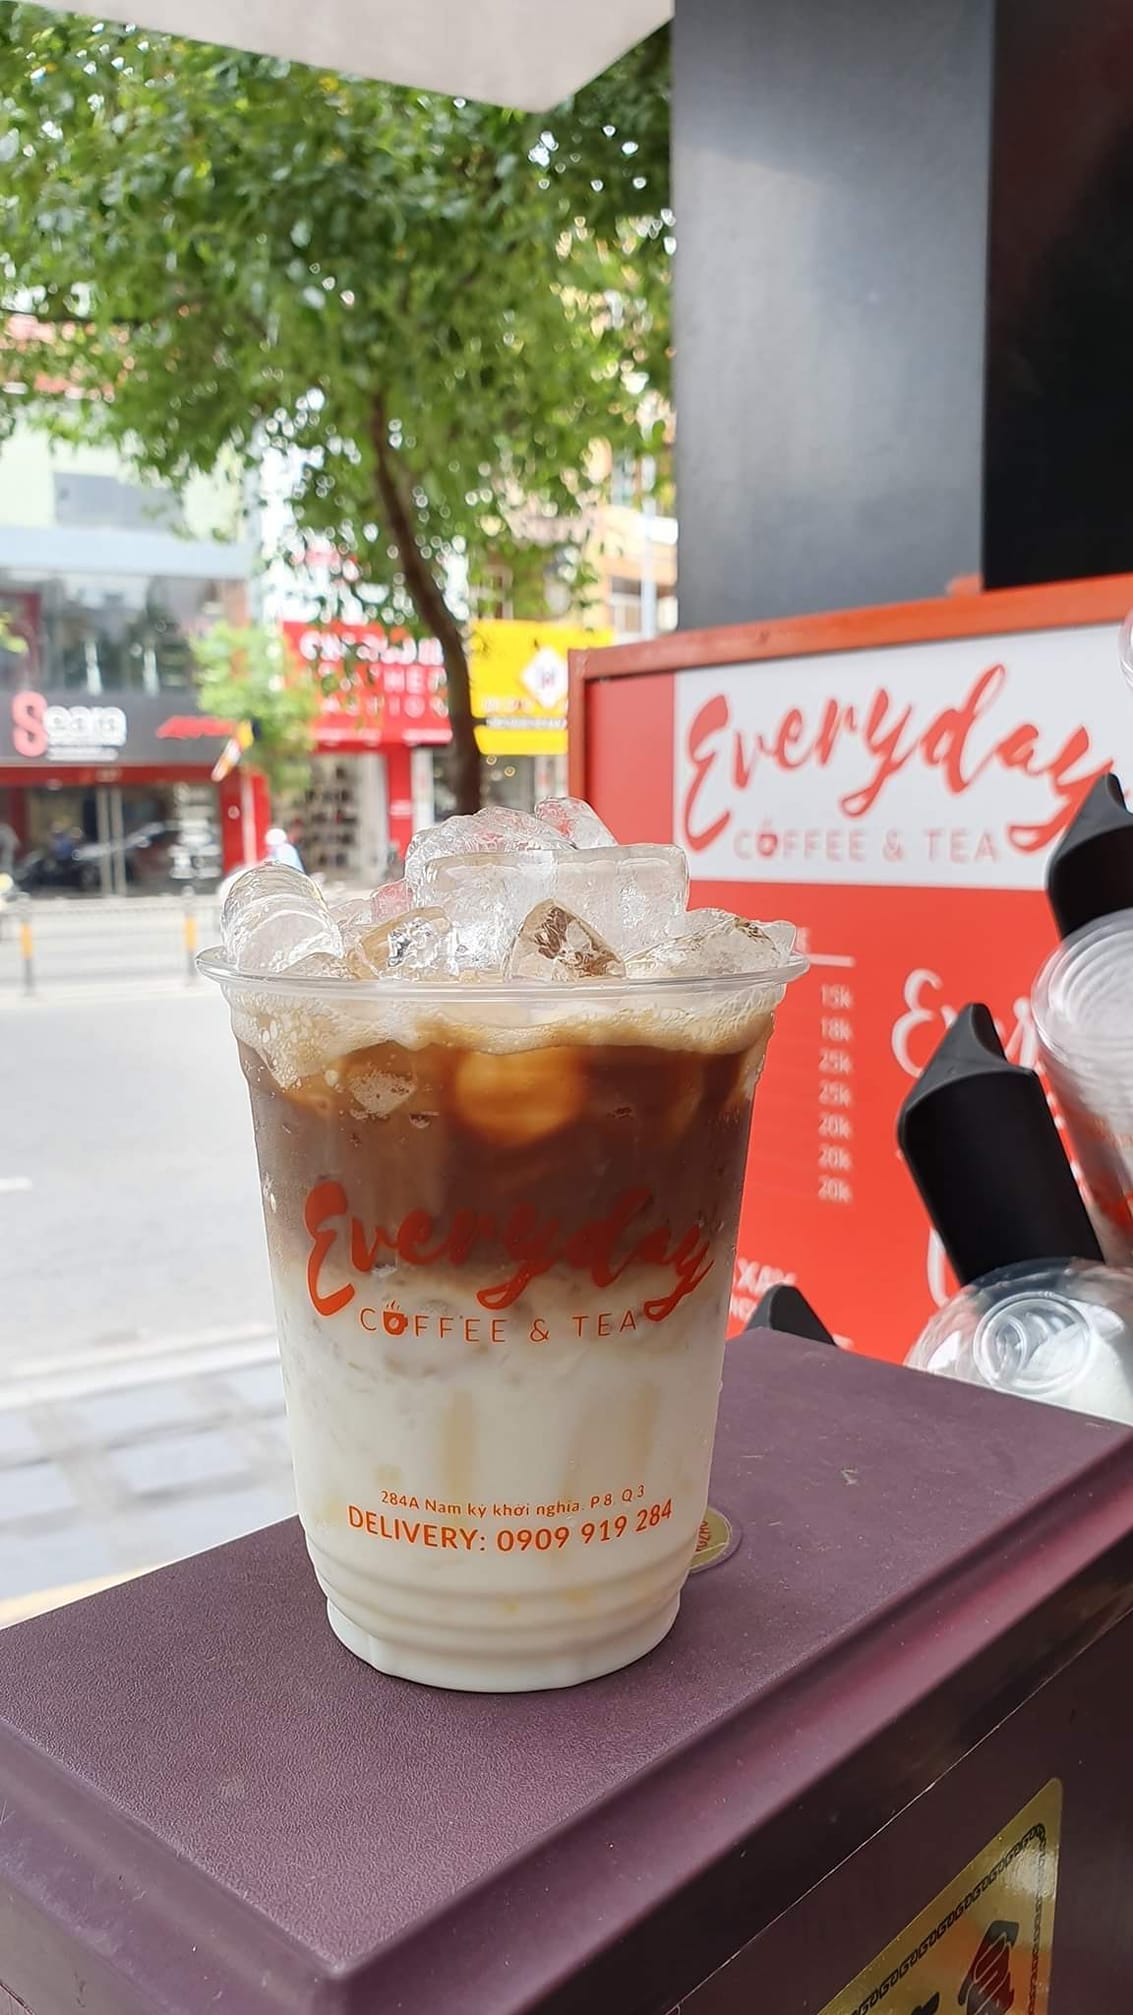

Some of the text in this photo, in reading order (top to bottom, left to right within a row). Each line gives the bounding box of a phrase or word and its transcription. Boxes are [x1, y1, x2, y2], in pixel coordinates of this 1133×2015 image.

[683, 663, 1114, 853] Everyday
[732, 823, 998, 863] COFFEE & TEA
[304, 1179, 716, 1322] Everyday
[359, 1304, 637, 1343] COFFEE & TEA
[348, 1498, 673, 1552] DELIVERY: 0909 919 284
[381, 1490, 420, 1510] 284A
[425, 1499, 461, 1515] Nam
